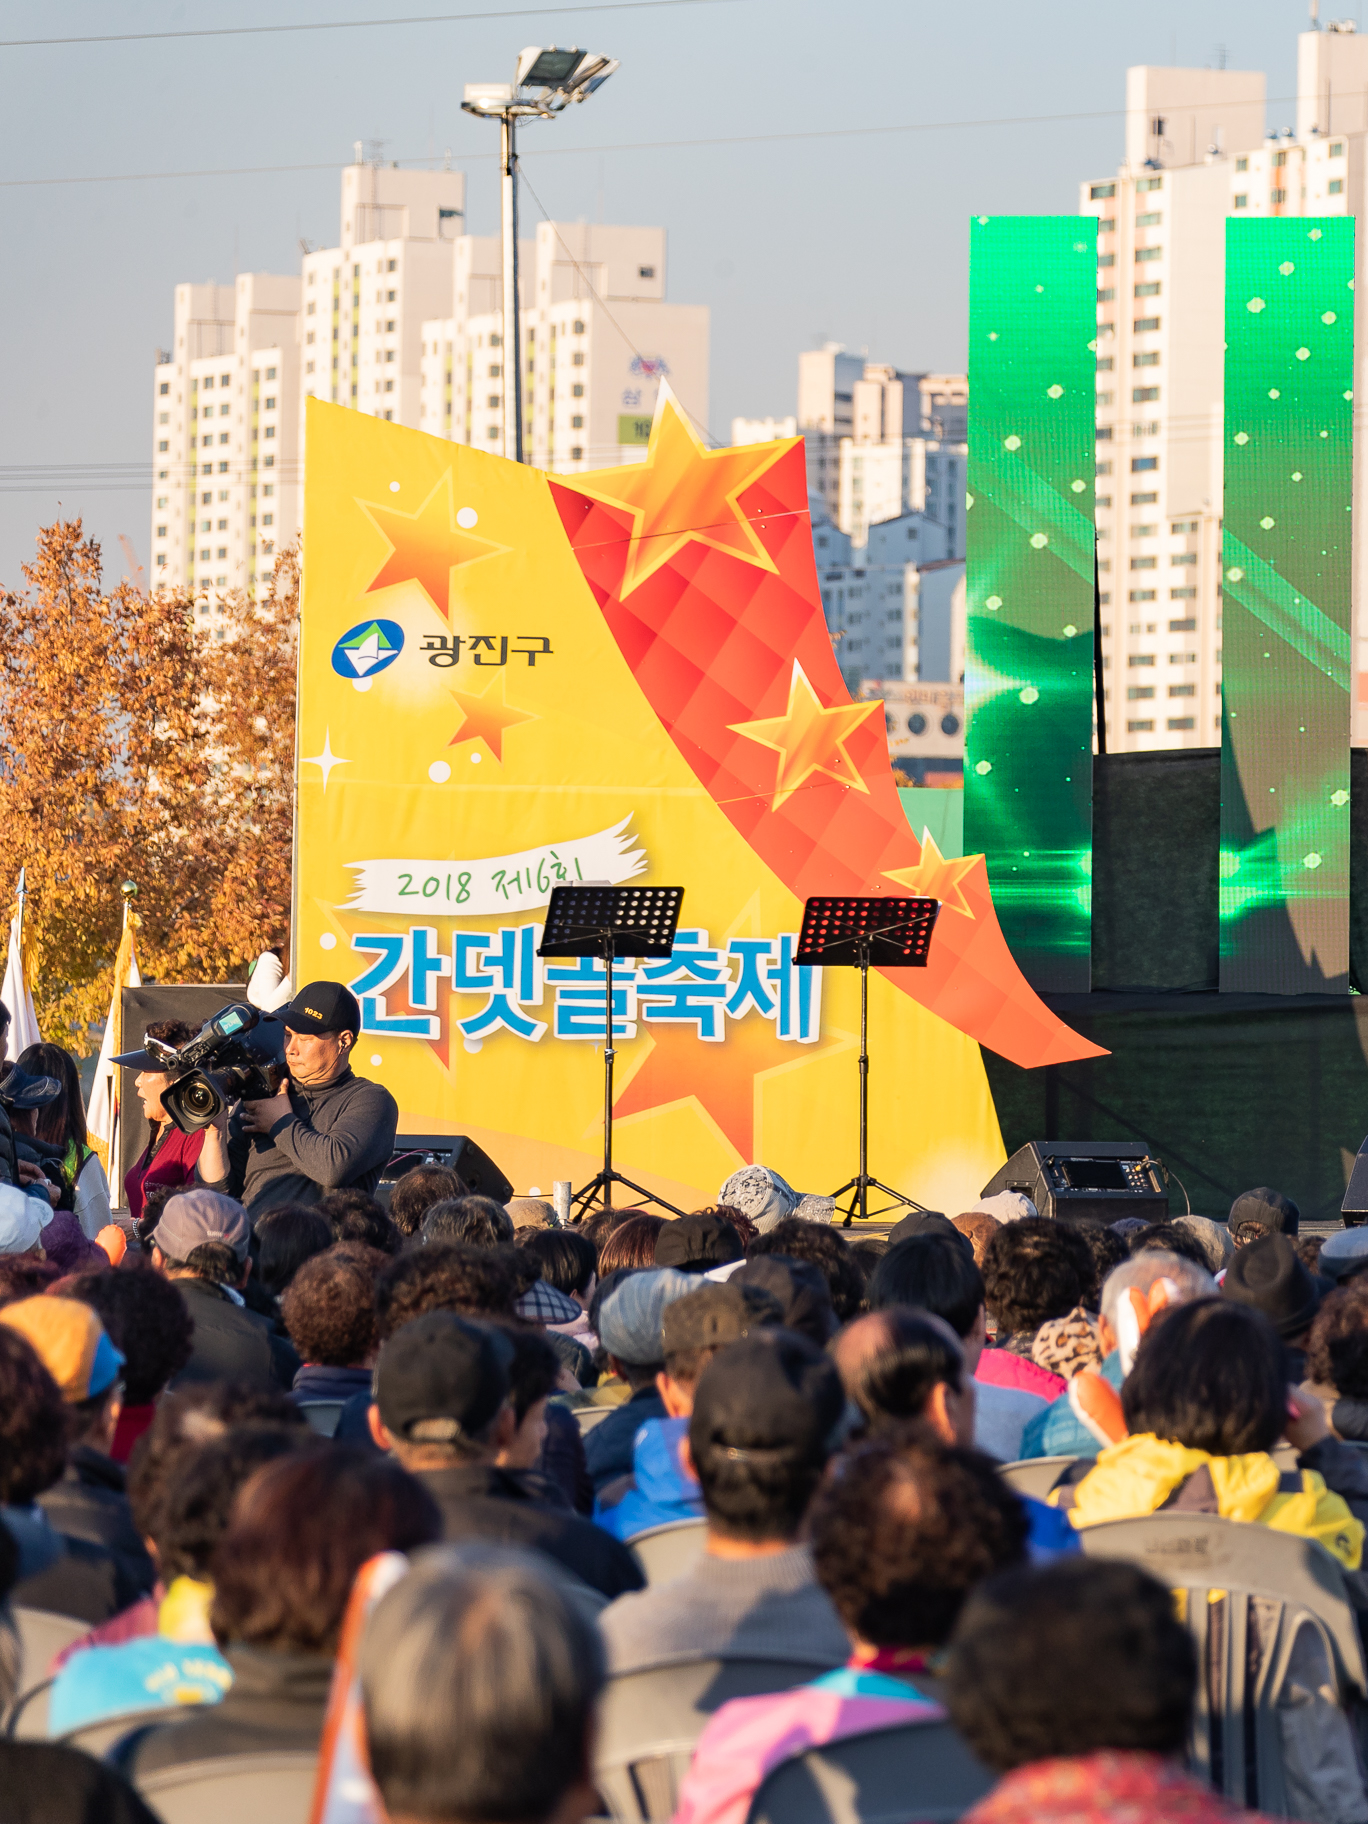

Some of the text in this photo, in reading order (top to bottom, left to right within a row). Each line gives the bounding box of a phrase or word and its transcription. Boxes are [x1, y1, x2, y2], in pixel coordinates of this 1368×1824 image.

[419, 634, 554, 668] 광진구
[397, 871, 472, 904] 2018
[304, 1006, 324, 1020] 1023
